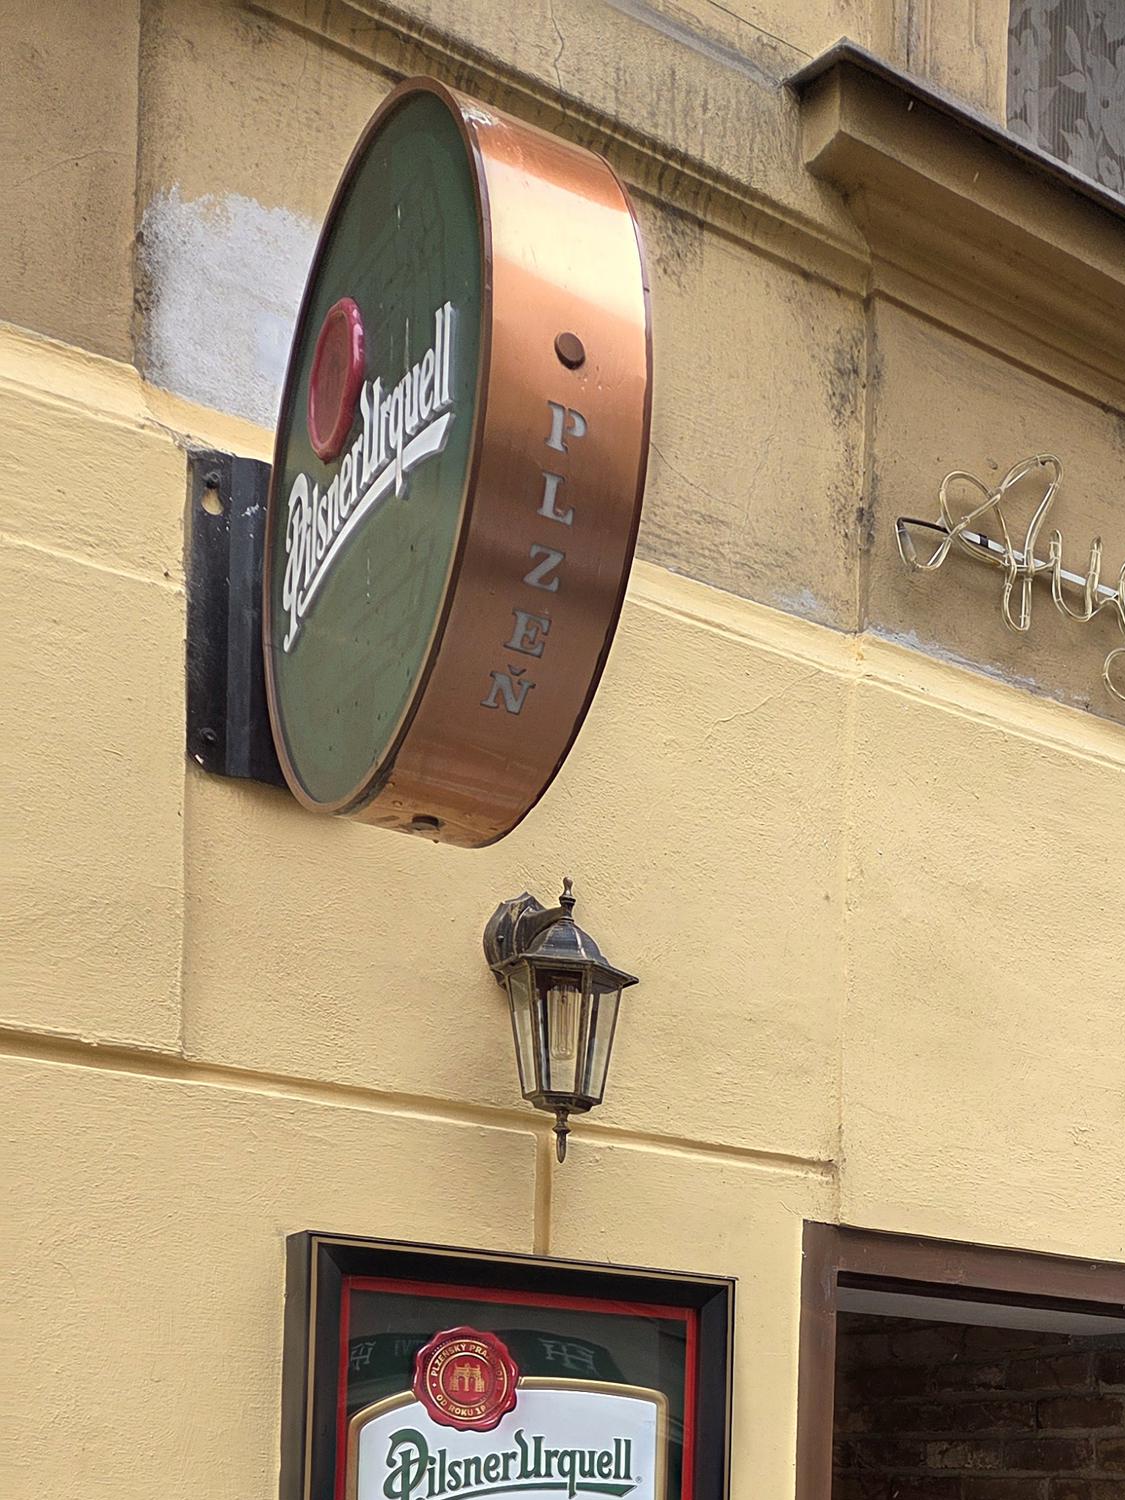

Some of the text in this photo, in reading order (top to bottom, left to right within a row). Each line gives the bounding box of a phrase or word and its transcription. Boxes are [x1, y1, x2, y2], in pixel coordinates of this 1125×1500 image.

[283, 301, 456, 653] Pilsner Urquell
[481, 399, 587, 716] PLZEŇ
[514, 1429, 632, 1499] Urquell
